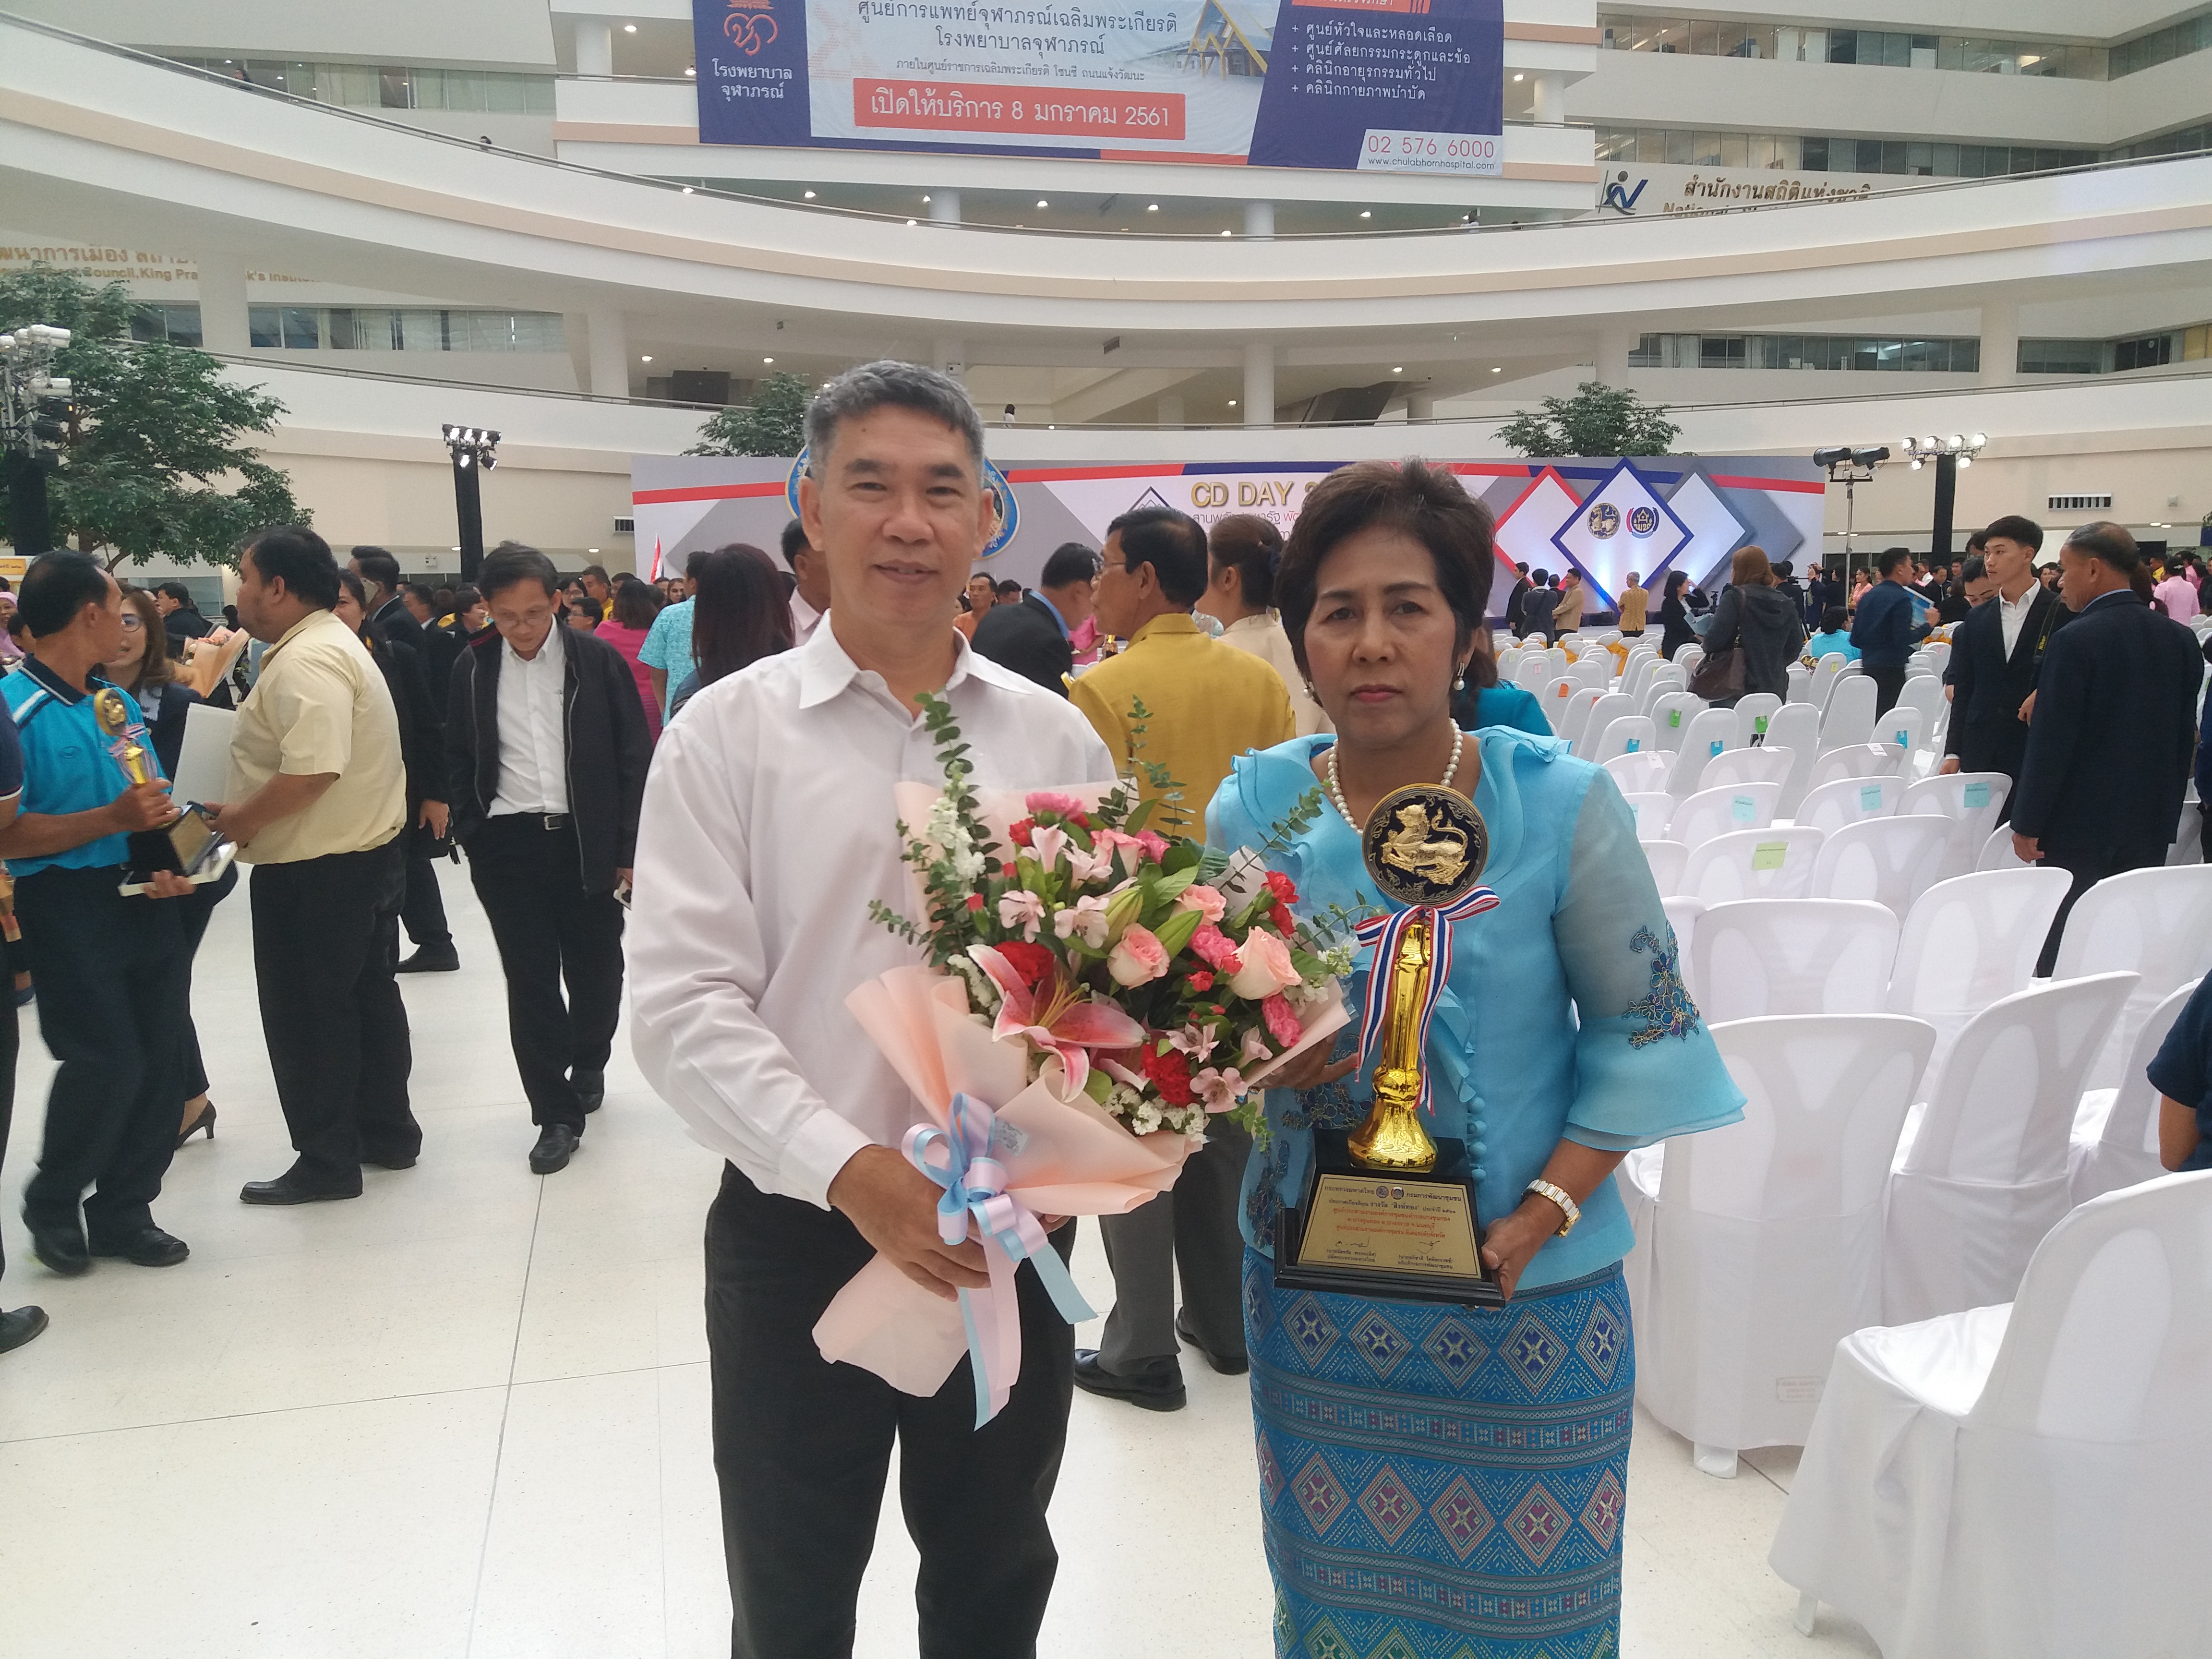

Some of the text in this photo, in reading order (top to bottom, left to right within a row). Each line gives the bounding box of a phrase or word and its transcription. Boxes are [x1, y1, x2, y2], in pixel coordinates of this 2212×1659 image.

[859, 0, 1177, 32] ศูนยการแพทย์จุฬาภรณ์เฉลิมพระเกียรติ
[935, 25, 1105, 59] โรงพยาบาลจุฬาภรณ์
[1307, 20, 1452, 43] ศูนย์หัวใจและหลอดเลือด
[711, 58, 793, 80] โรงพยาบาล
[1082, 67, 1145, 81] ถนนแจ้งวัฒนะ
[1306, 60, 1436, 82] คลินิกอายุรกรรมทั่วไป
[721, 82, 785, 102] จุฬาภรณ์
[1306, 79, 1425, 100] คลินิกกายภาพบำบัด
[871, 86, 1168, 126] เปิดให้บริการ 8 มกราคม 2561
[1368, 135, 1494, 158] 02 576 6000
[1368, 157, 1494, 170] www.chulabhornhospital.com
[1191, 482, 1228, 507] CD
[1238, 481, 1293, 506] DAY
